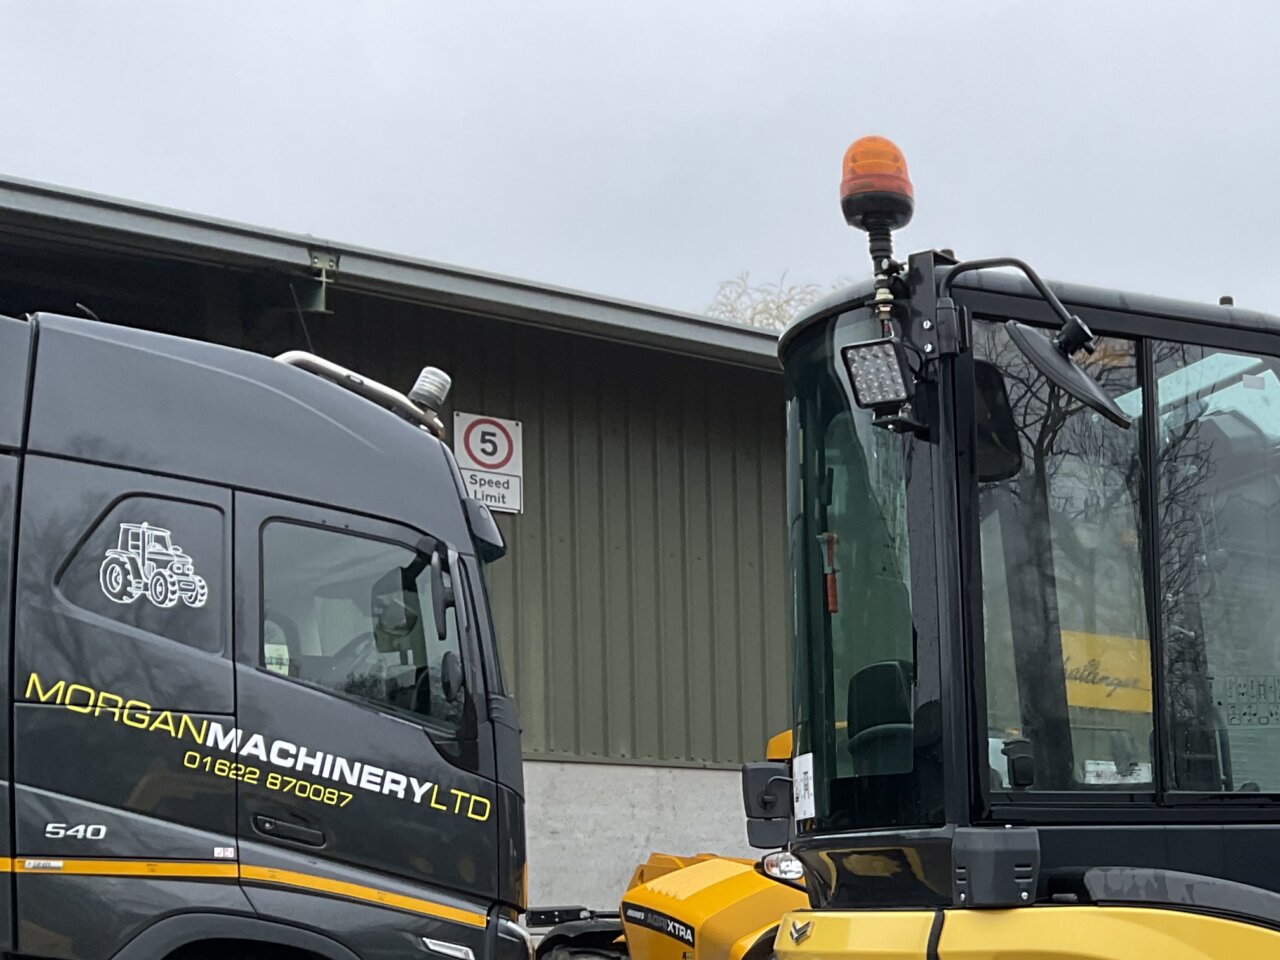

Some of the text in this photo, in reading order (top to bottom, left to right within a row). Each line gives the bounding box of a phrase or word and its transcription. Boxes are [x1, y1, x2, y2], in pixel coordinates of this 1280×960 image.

[480, 431, 498, 456] 5
[469, 474, 510, 490] Speed
[474, 490, 506, 504] Limit
[184, 751, 353, 807] 01622 870087
[45, 823, 107, 840] 540
